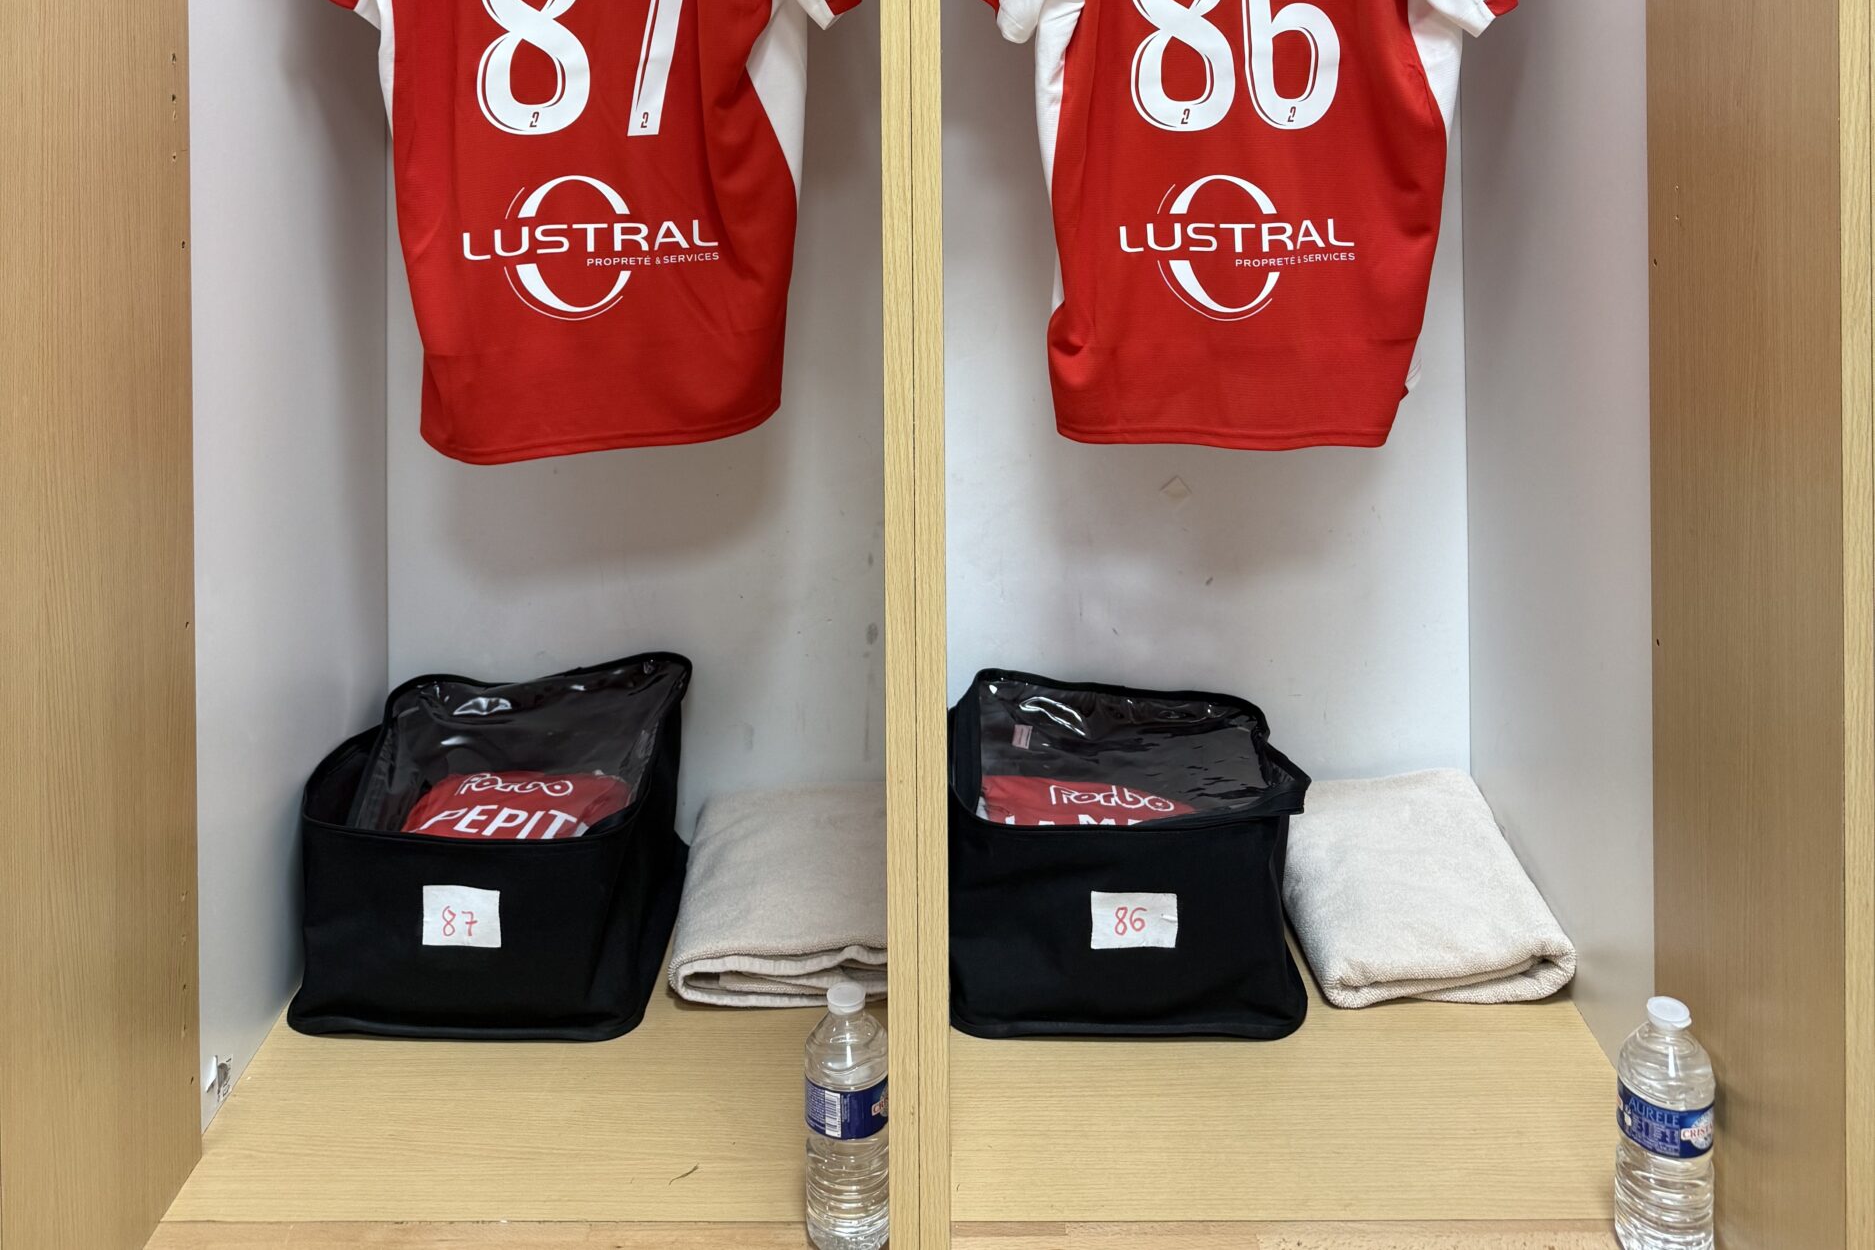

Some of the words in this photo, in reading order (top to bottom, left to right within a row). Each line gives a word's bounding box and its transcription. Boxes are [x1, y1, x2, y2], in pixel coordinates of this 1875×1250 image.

[462, 219, 719, 261] LUSTRAL
[1119, 218, 1355, 253] LUSTRAL
[586, 254, 651, 267] PROPRETÉ
[662, 252, 720, 264] SERVICES
[1235, 256, 1296, 268] PROPRETÉ
[1303, 252, 1356, 263] SERVICES
[442, 905, 478, 937] 87
[1114, 906, 1147, 936] 86
